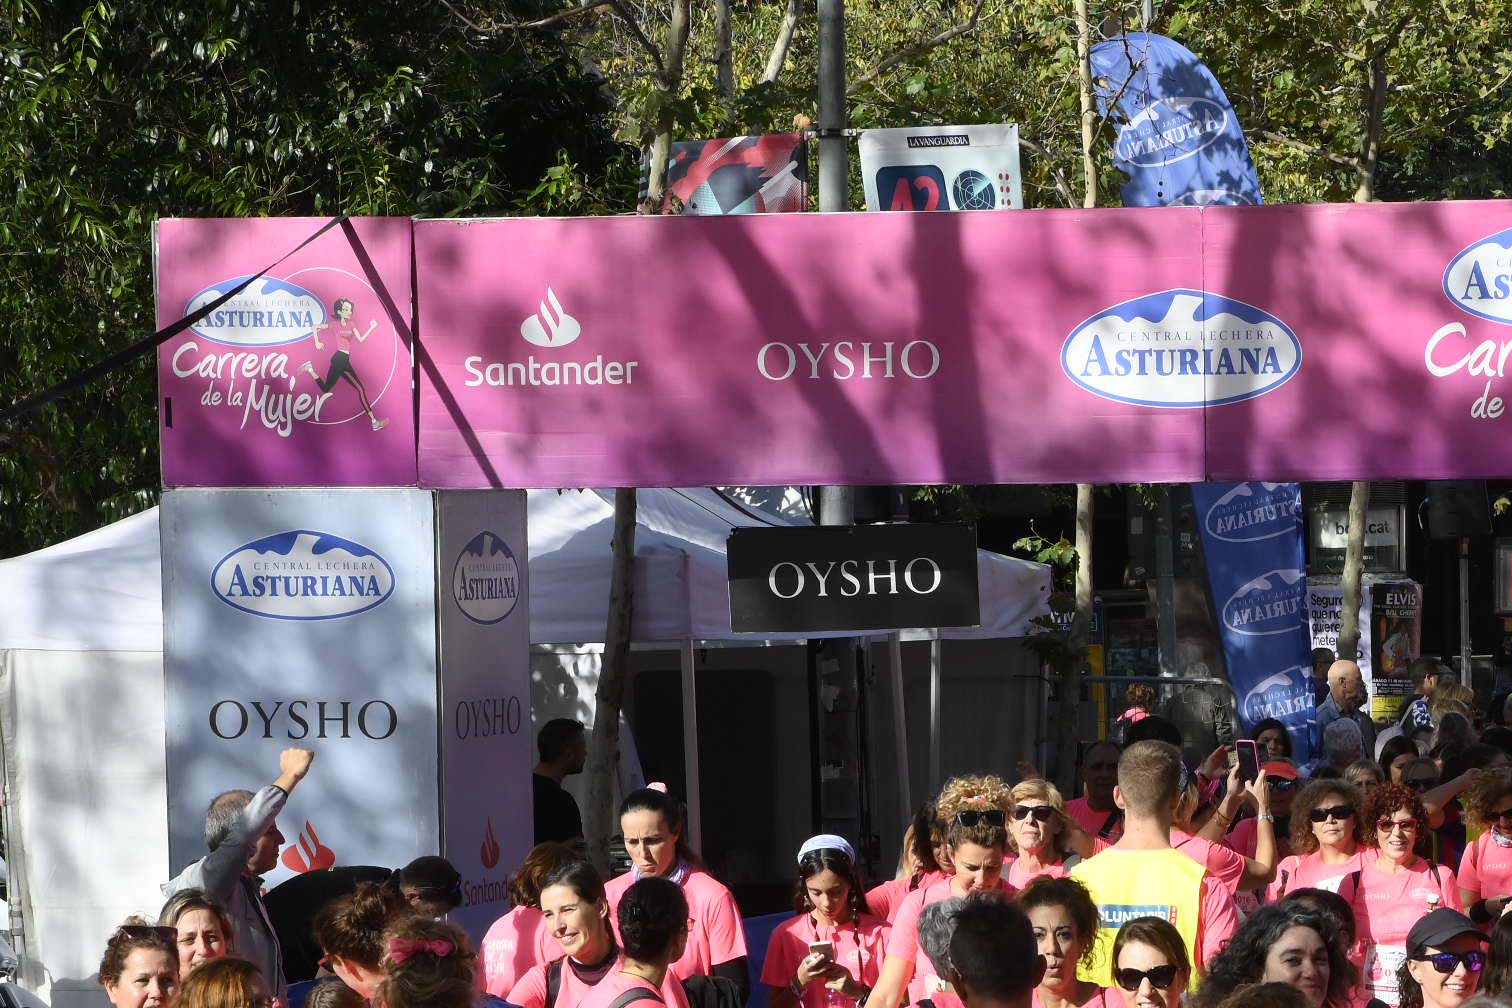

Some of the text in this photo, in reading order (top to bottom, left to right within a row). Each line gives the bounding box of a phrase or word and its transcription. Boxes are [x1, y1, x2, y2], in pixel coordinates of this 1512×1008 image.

[918, 136, 969, 147] VANGUARDIA
[195, 301, 316, 328] ASTURIANA
[1116, 327, 1274, 342] CENTRAL LECHERA
[172, 341, 289, 379] Carrera
[464, 355, 639, 387] Santander
[757, 340, 941, 382] OYSHO
[1081, 333, 1279, 378] ASTURIANA
[201, 375, 333, 438] de la Mujer
[1470, 382, 1504, 420] de
[226, 563, 381, 598] ASTURIANA
[254, 561, 376, 571] CENTRAL LECHERA
[459, 566, 516, 602] ASTURIANA
[768, 557, 942, 599] OYSHO
[1386, 592, 1416, 606] ELVIS
[208, 700, 398, 740] OYSHO
[456, 695, 521, 740] OYSHO
